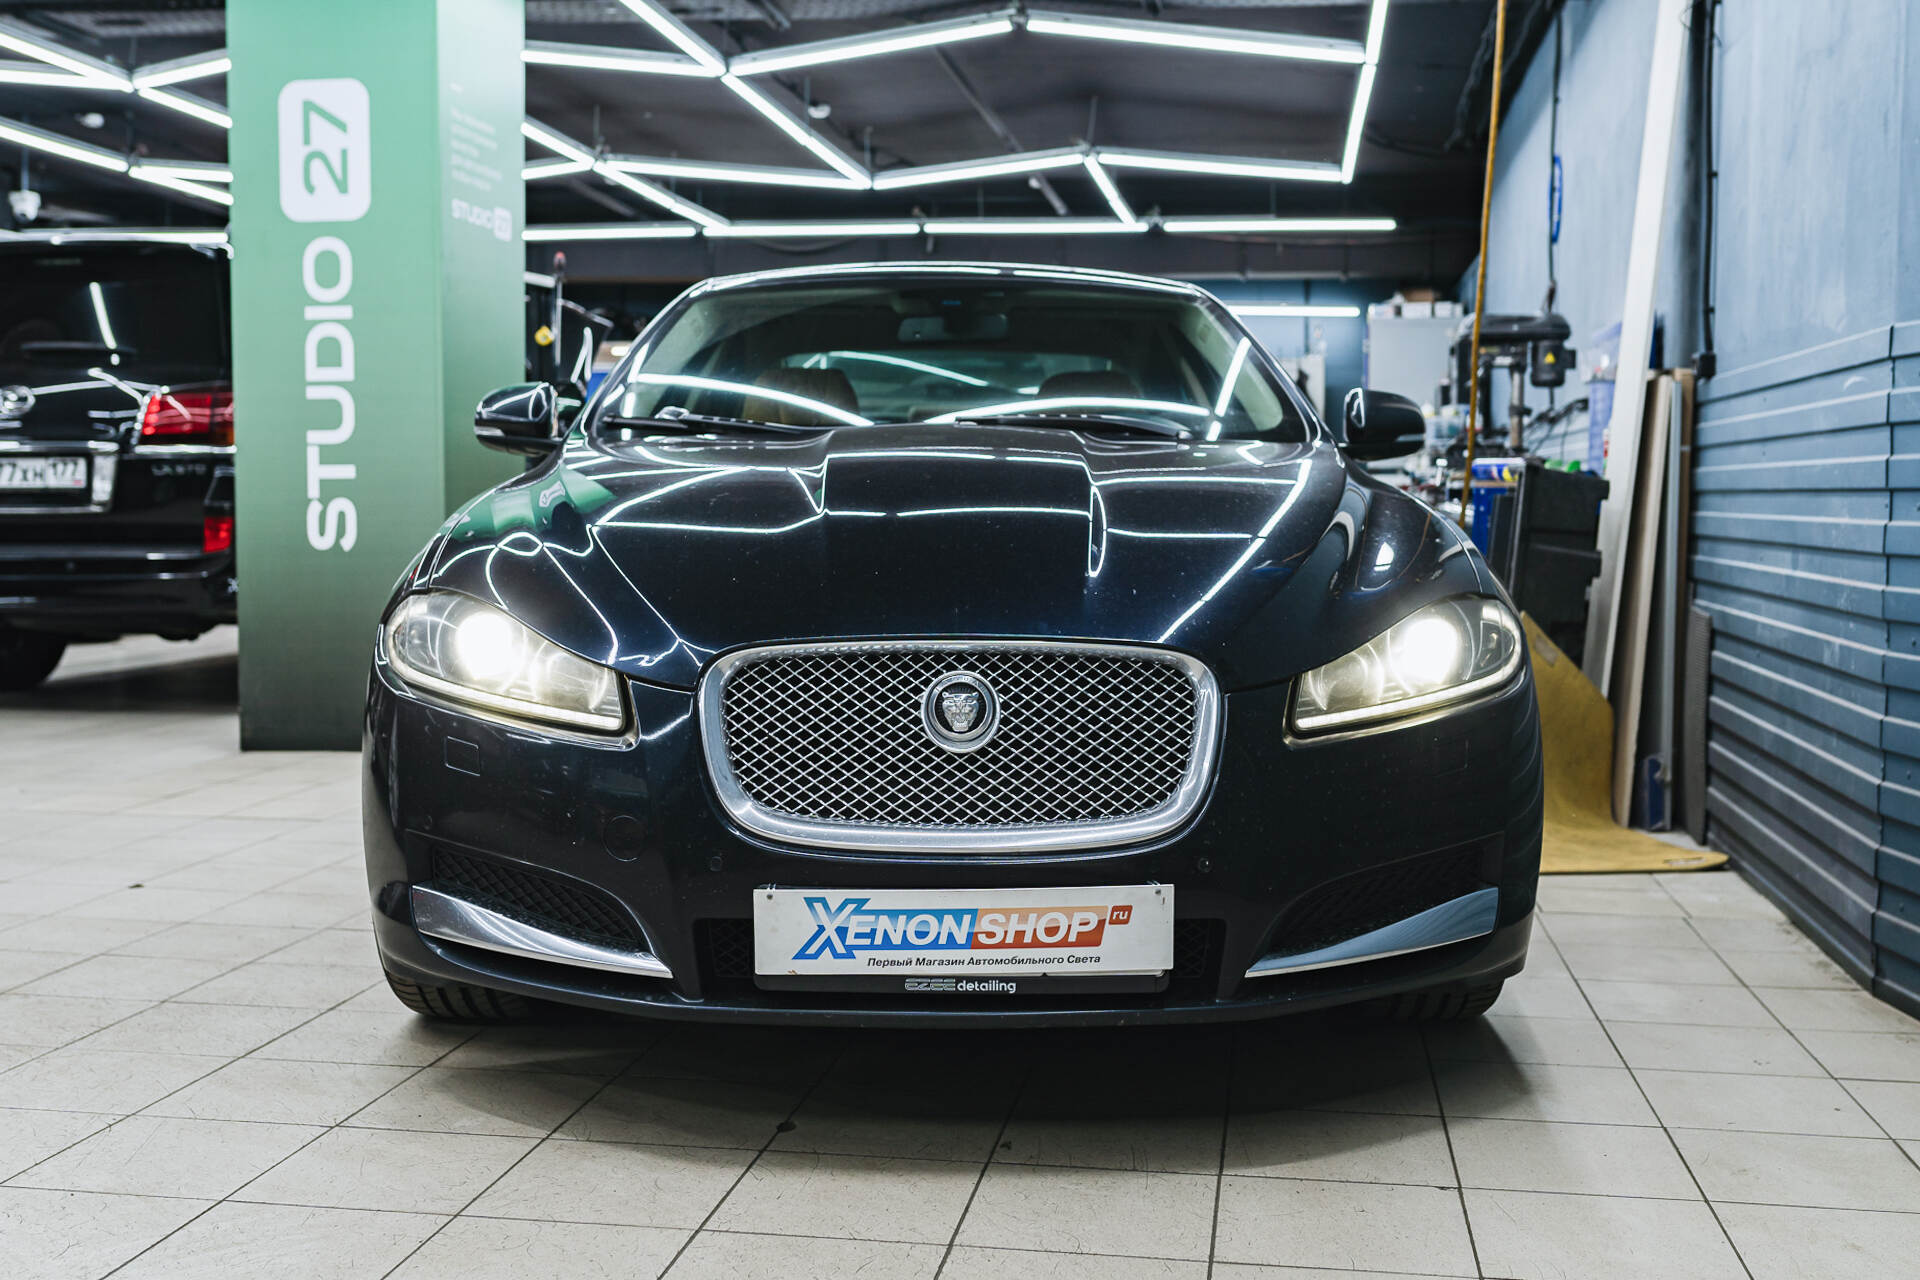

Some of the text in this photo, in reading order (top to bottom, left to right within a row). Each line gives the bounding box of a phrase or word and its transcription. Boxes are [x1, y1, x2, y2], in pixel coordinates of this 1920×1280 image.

[302, 98, 358, 552] STUDIO 27
[1112, 910, 1129, 920] ru
[867, 954, 1101, 968] Первый Магазин Автомобильного Света
[957, 980, 1017, 994] detailing
